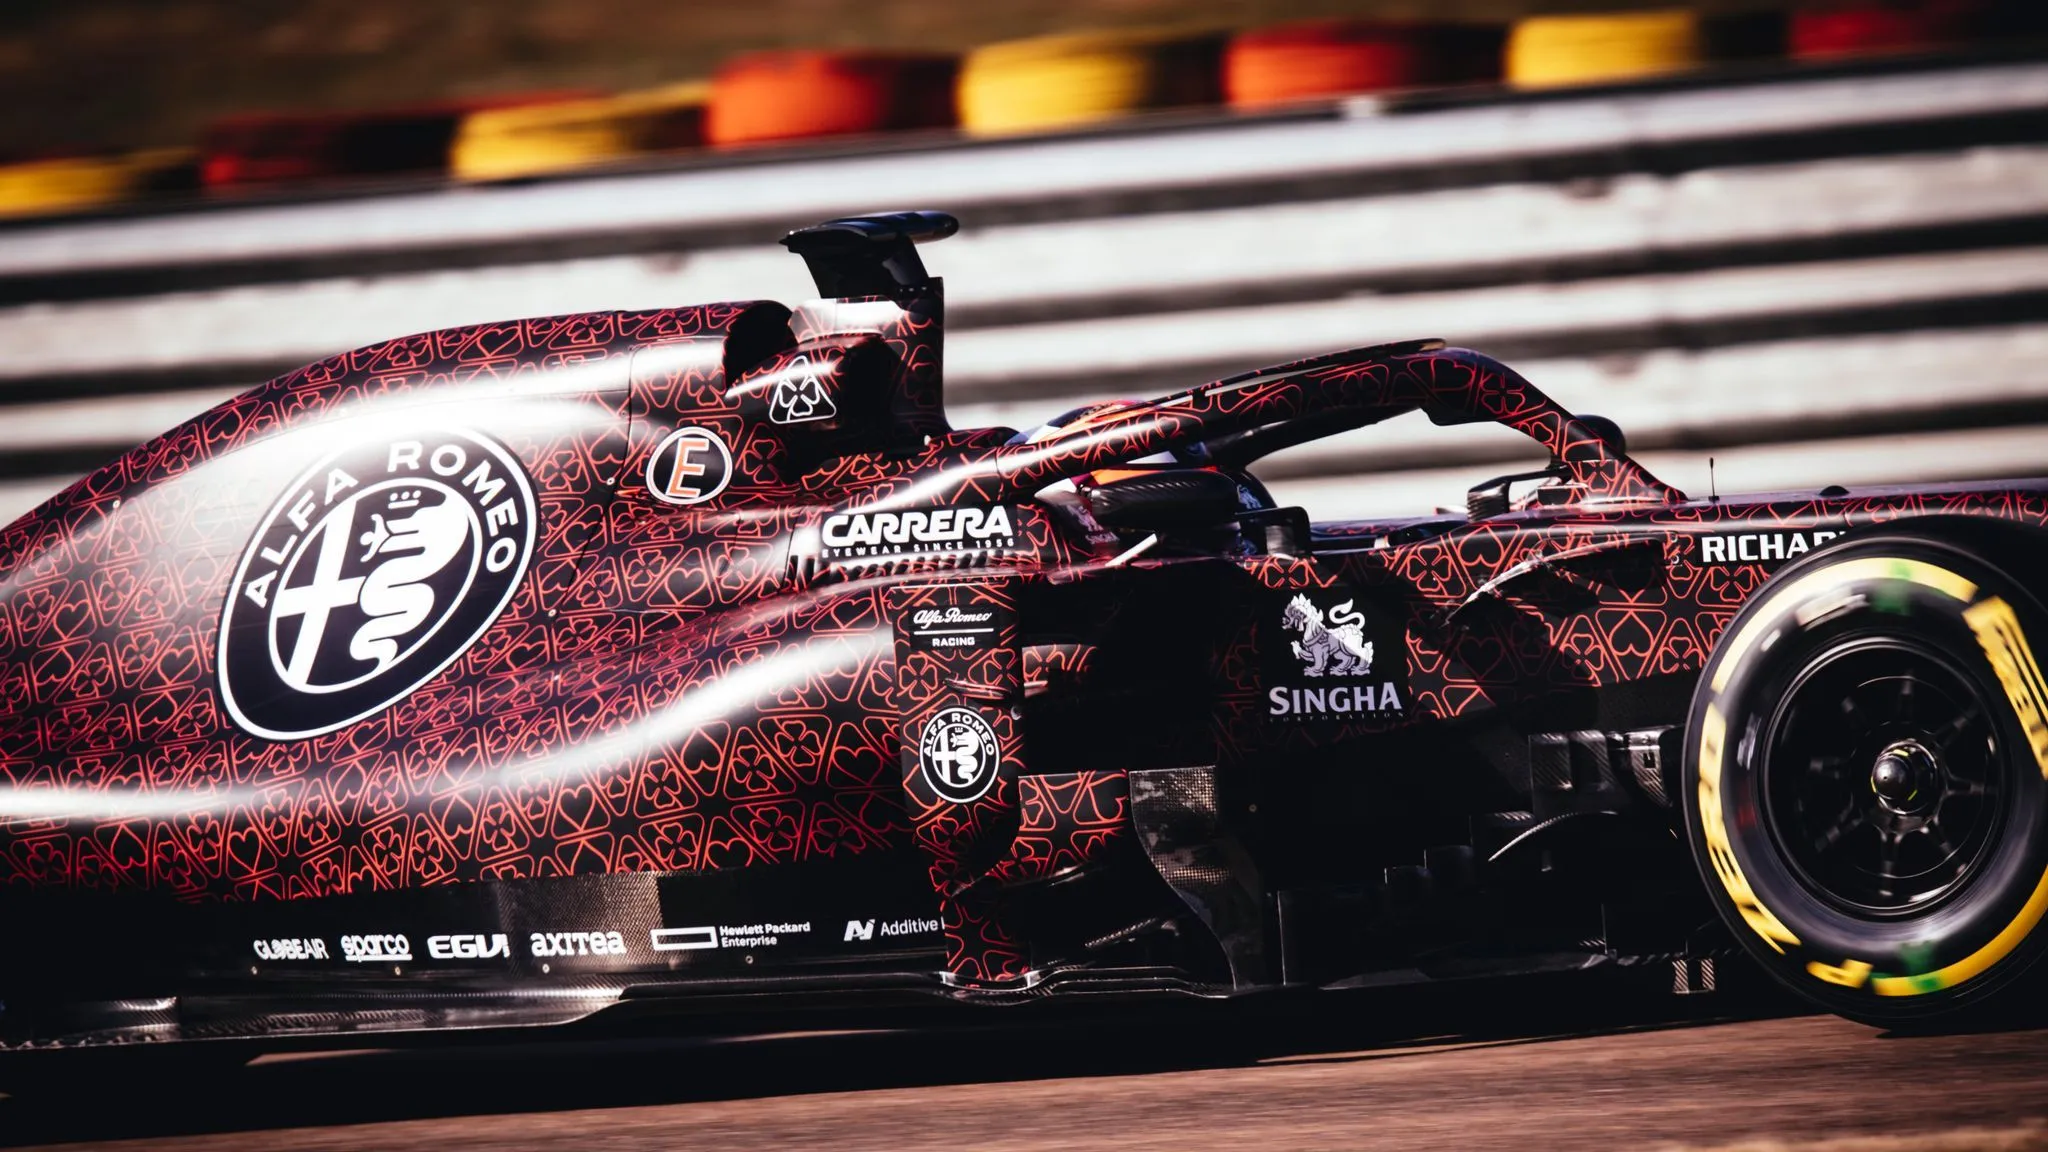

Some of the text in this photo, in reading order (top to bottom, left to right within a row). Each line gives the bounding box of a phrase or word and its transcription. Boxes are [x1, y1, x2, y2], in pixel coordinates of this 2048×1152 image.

[665, 437, 710, 498] E
[245, 440, 519, 608] ALFA ROMEO
[821, 505, 1014, 547] CARRERA
[822, 538, 1015, 558] EYEWEAR SINCE 1956
[1701, 531, 1846, 563] RICHA
[913, 607, 993, 630] Alfa Romeo
[932, 636, 976, 647] RACING
[1268, 682, 1403, 715] SINGHA
[923, 712, 995, 757] ALFA ROMEO
[719, 921, 811, 937] Hewlett Packard
[880, 917, 939, 936] Additive
[340, 934, 410, 962] sparco
[721, 935, 778, 949] Enterprise
